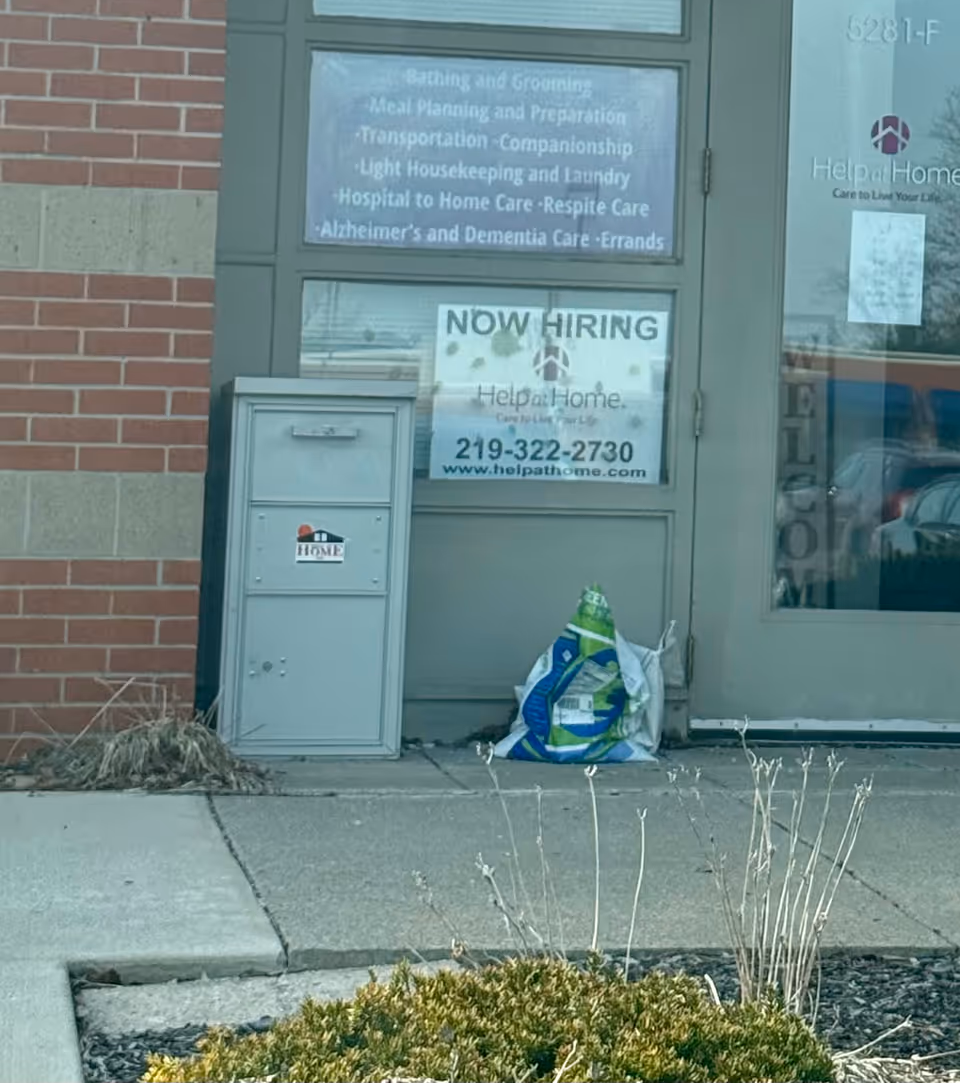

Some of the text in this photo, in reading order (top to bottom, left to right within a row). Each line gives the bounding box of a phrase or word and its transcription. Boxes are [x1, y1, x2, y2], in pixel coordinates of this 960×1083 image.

[847, 13, 943, 46] 5281-F
[476, 69, 505, 90] and
[512, 71, 593, 98] Grooming
[417, 98, 490, 124] Planning
[495, 102, 526, 121] and
[531, 105, 627, 127] Preparation
[407, 161, 524, 186] Housekeeping
[528, 163, 559, 184] and
[565, 166, 631, 190] Laundry
[812, 156, 868, 188] Help
[416, 191, 434, 208] to
[440, 192, 490, 212] Home
[496, 194, 533, 213] Care
[611, 197, 650, 218] Care
[832, 187, 855, 200] Care
[858, 188, 870, 200] to
[872, 189, 893, 201] Live
[895, 191, 919, 203] Your
[427, 225, 459, 244] and
[465, 226, 547, 246] Dementia
[553, 228, 590, 248] Care
[446, 308, 659, 341] NOW HIRING
[477, 383, 530, 412] Help
[456, 437, 634, 463] 219-322-2730
[443, 463, 647, 479] www.helpathome.com
[297, 543, 344, 557] HOME
